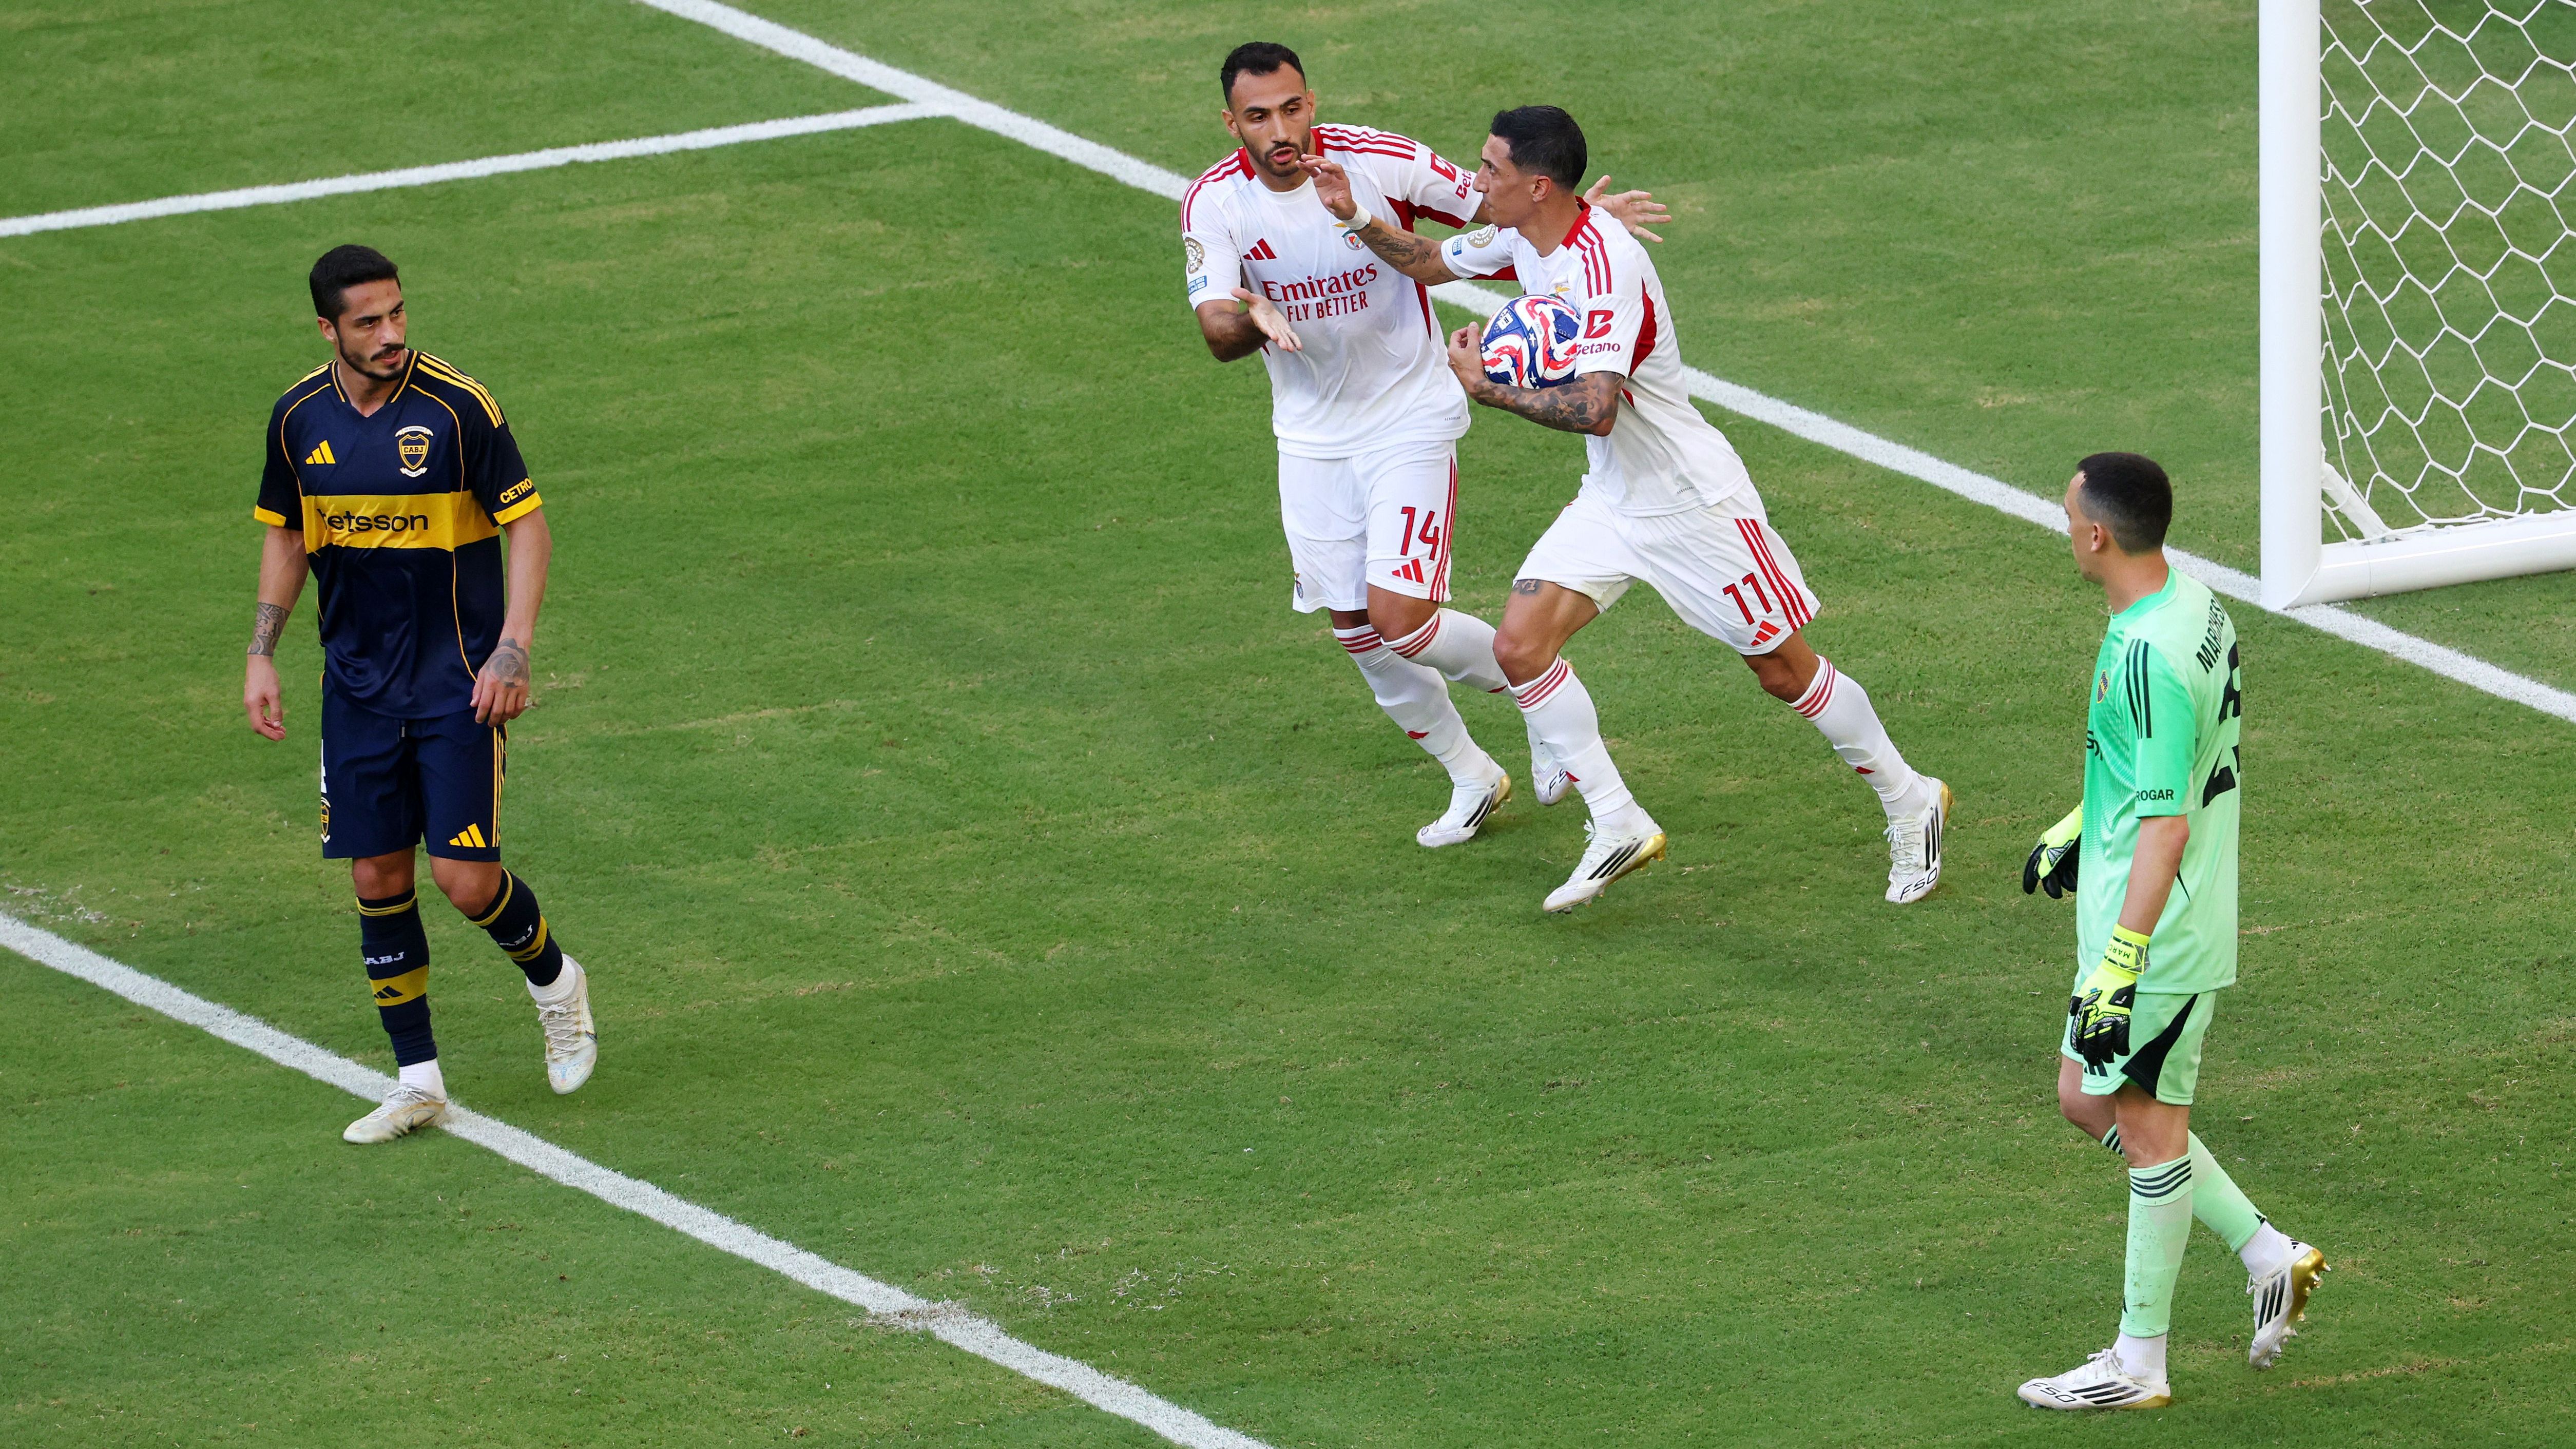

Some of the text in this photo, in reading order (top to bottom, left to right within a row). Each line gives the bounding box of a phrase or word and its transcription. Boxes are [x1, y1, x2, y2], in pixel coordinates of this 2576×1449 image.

[1261, 263, 1378, 302] Emirates
[1286, 291, 1369, 322] FLY BETTER
[500, 478, 533, 504] CETRO
[1400, 506, 1439, 561] 14
[1722, 572, 1773, 626] 11
